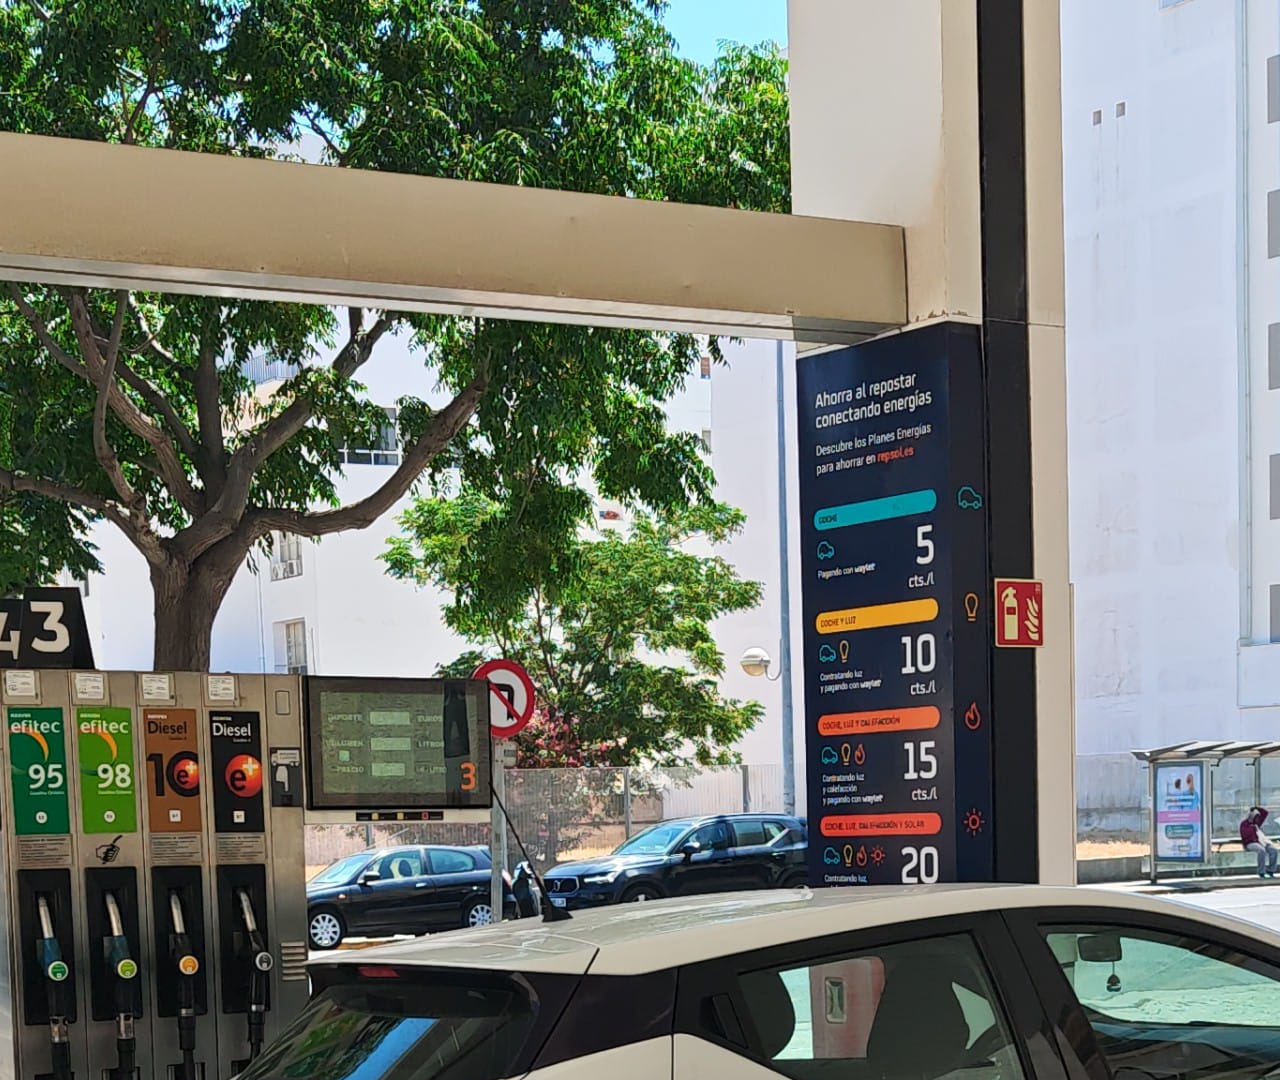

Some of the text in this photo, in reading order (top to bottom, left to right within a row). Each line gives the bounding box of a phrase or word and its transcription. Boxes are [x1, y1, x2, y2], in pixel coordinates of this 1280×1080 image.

[815, 373, 916, 409] Ahorra al repostar
[816, 389, 932, 429] conectando energías
[816, 423, 931, 456] Descubre los Planes Energías
[816, 446, 914, 477] para ahorrar en repsol.es
[916, 524, 934, 565] 5
[908, 571, 934, 588] cts./l
[30, 601, 70, 653] 3
[821, 618, 839, 628] COCHE
[901, 633, 936, 674] 10
[910, 680, 936, 695] cts./l
[10, 719, 61, 734] efitec
[80, 720, 129, 734] efitec
[148, 721, 187, 734] Diesel
[213, 723, 251, 737] Diesel
[904, 741, 937, 780] 15
[28, 763, 64, 789] 95
[97, 763, 131, 788] 98
[460, 762, 476, 790] 3
[911, 787, 937, 801] cts./l
[901, 846, 939, 884] 20
